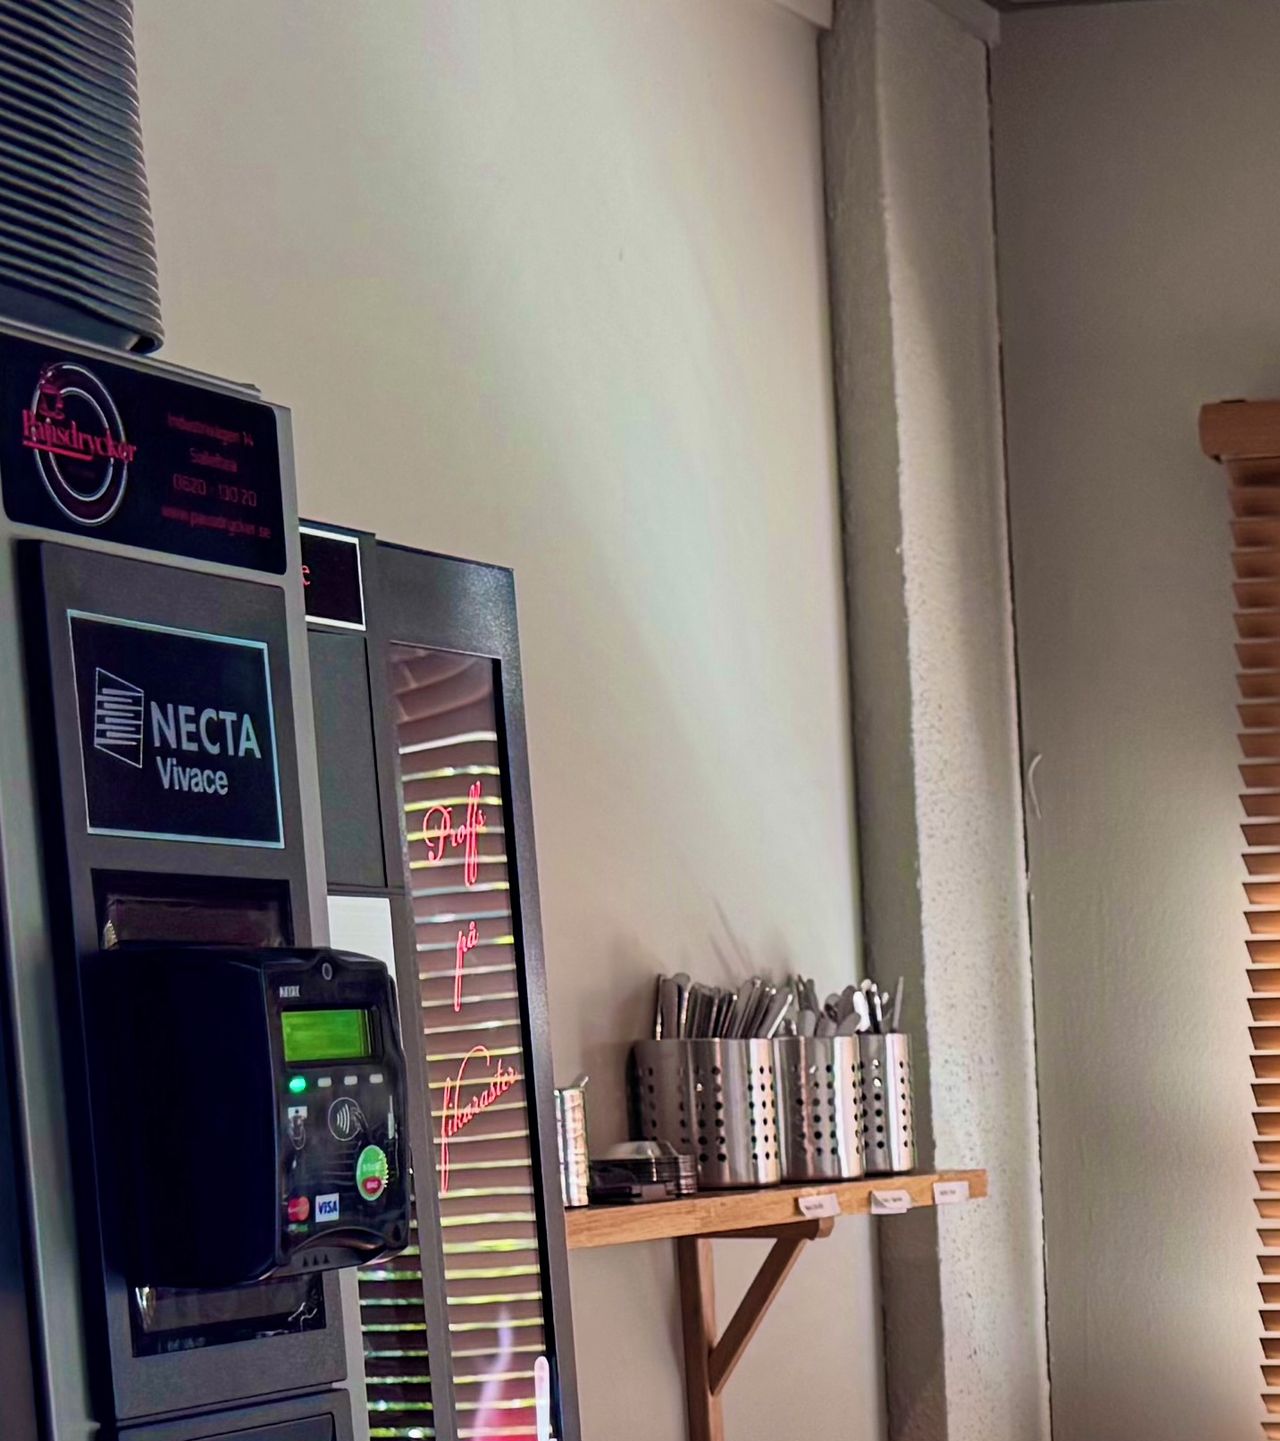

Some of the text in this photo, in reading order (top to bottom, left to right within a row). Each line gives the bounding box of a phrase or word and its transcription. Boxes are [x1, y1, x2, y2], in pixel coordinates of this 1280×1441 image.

[150, 700, 262, 760] NECTA
[156, 755, 229, 796] Vivace
[453, 920, 480, 1013] på
[317, 1200, 338, 1216] VISA
